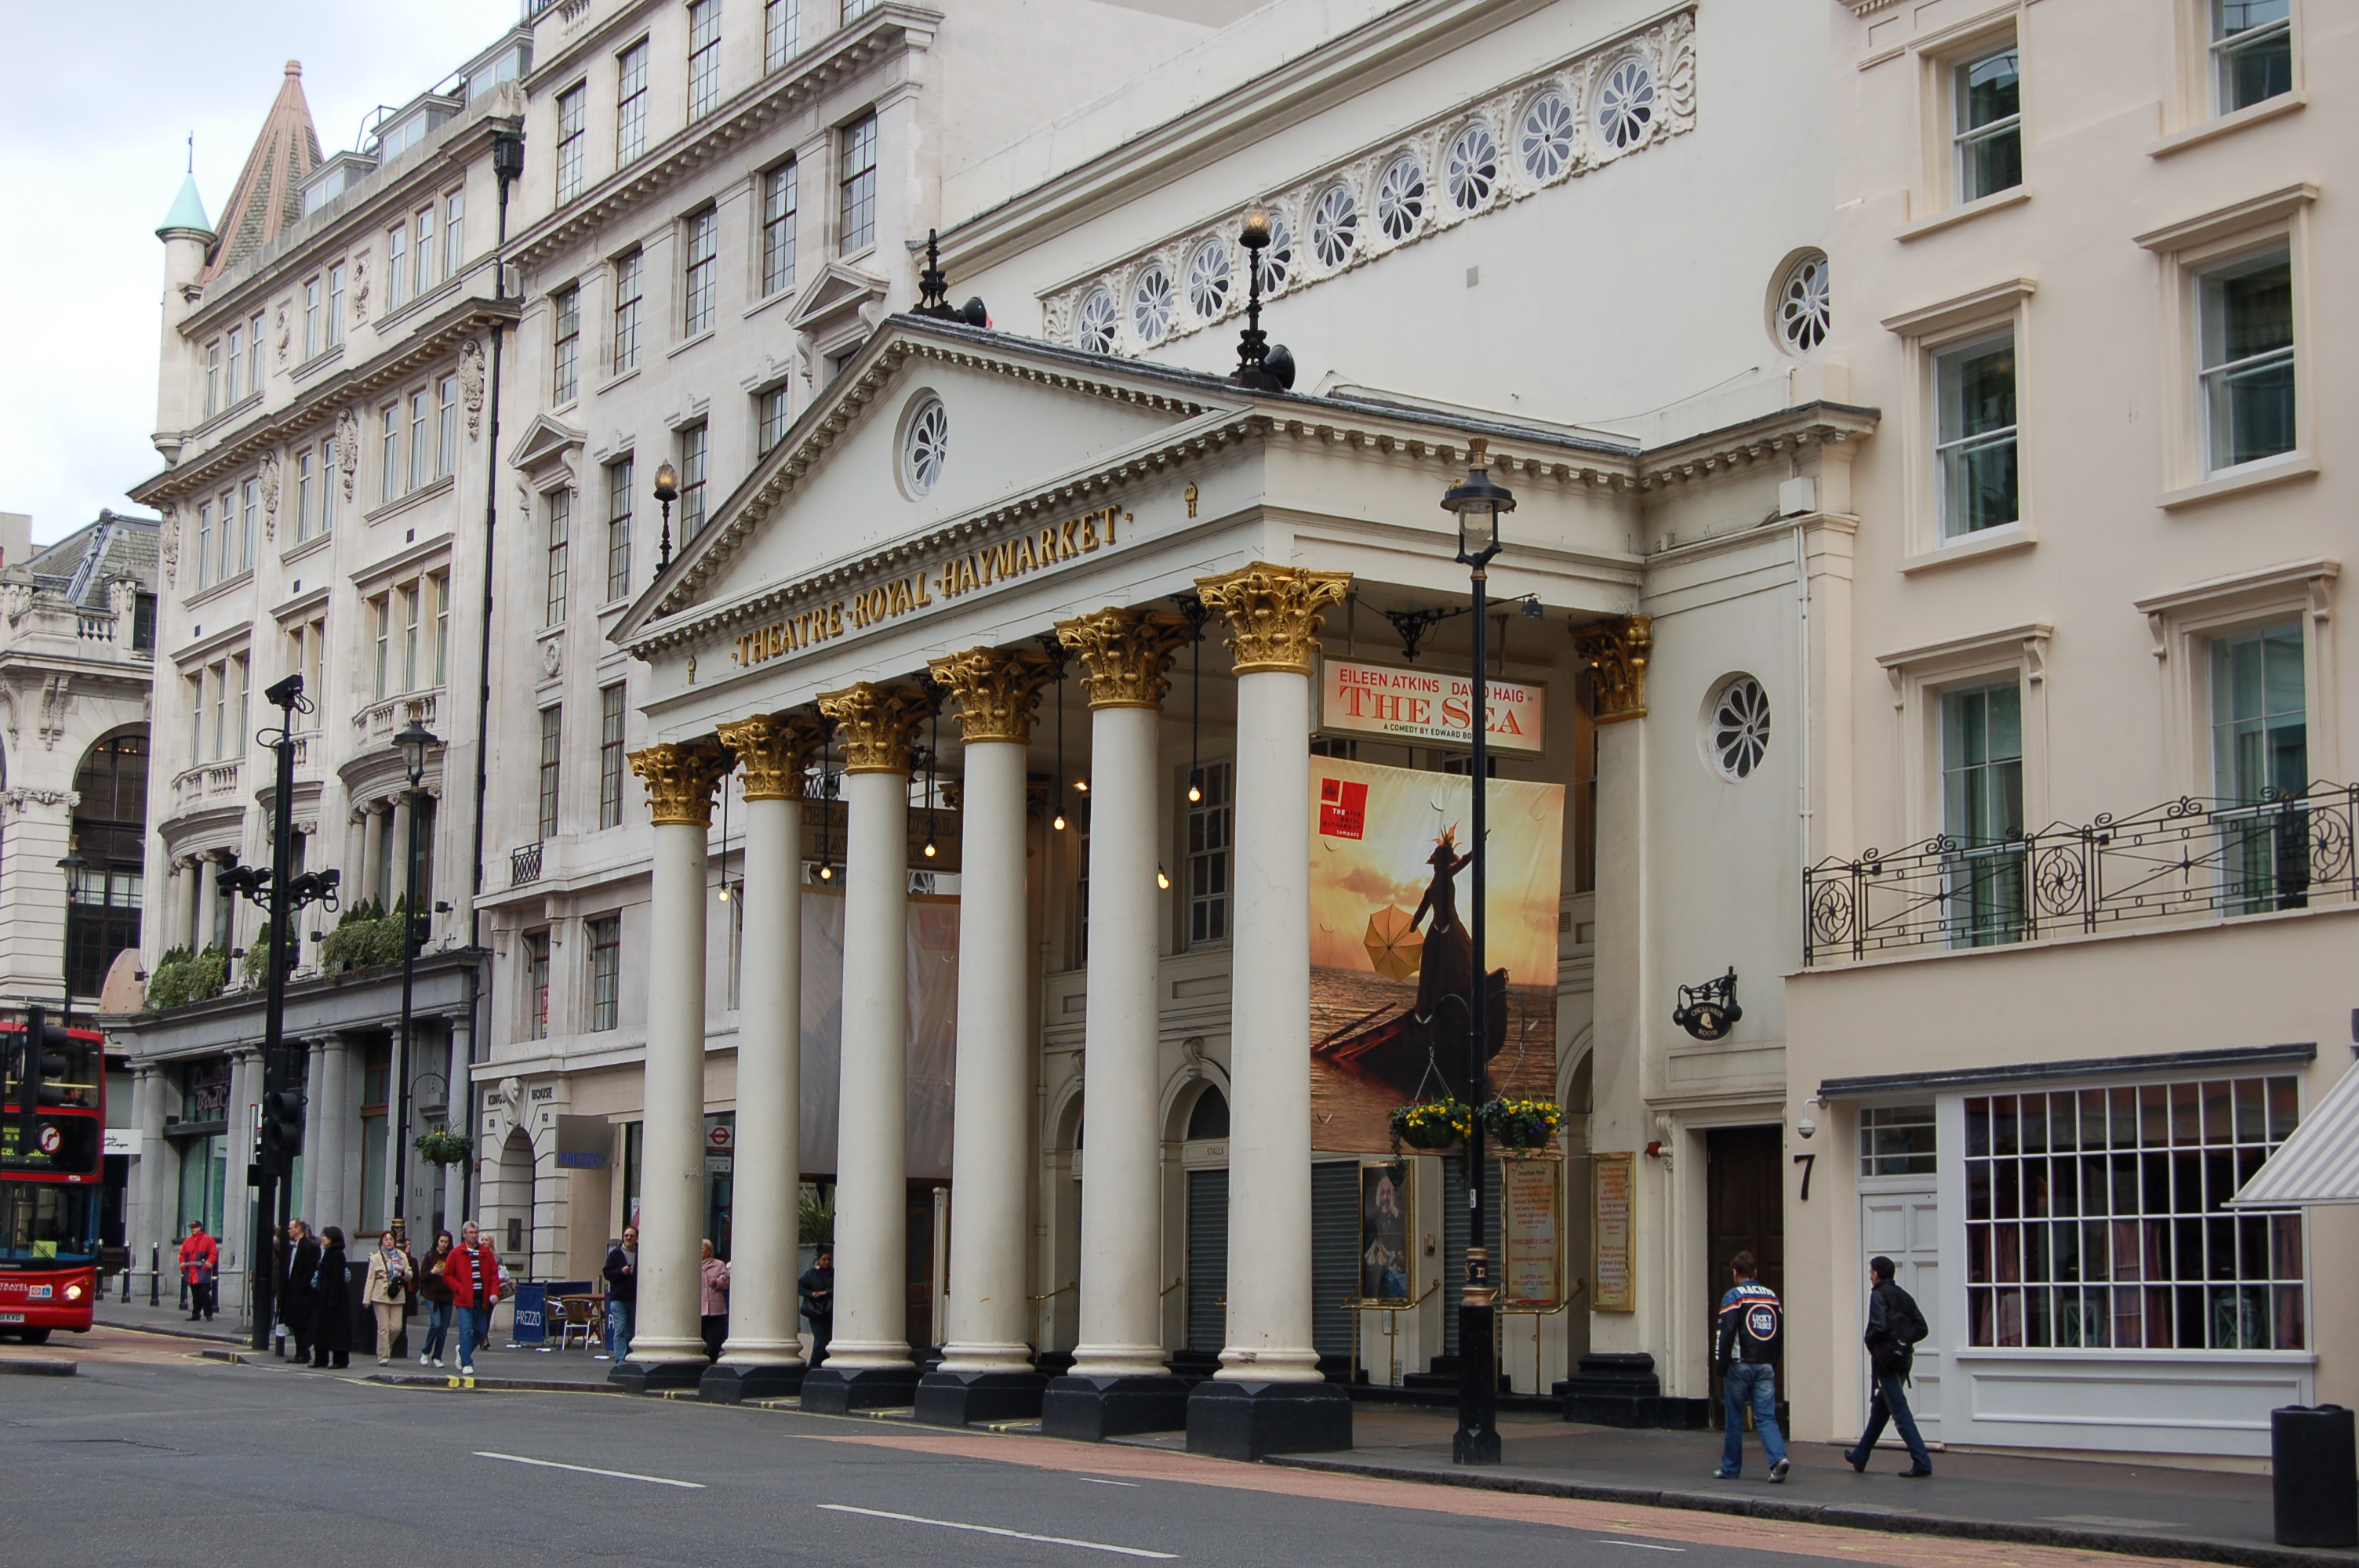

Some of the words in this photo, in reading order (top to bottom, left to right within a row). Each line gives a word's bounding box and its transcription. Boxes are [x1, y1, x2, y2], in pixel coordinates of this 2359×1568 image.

[736, 601, 844, 666] THEATRE
[852, 572, 932, 628] ROYAL
[940, 504, 1121, 597] HAYMARKET
[1339, 669, 1388, 687] EILEEN
[1391, 675, 1440, 693] ATKINS
[1452, 681, 1489, 699] DAVD
[1493, 687, 1524, 703] HAIG
[1339, 685, 1430, 724] THE
[1441, 697, 1524, 735] SEA
[1390, 724, 1418, 733] COMEDY
[1430, 728, 1460, 739] EDWARD
[1698, 1028, 1718, 1036] ROOM
[532, 1087, 552, 1101] HOUSE
[1206, 1147, 1224, 1156] STALLS
[559, 1152, 605, 1167] PREZZO
[1794, 1154, 1816, 1200] 7
[516, 1310, 541, 1326] PREZZO
[1752, 1314, 1772, 1323] LUCKY
